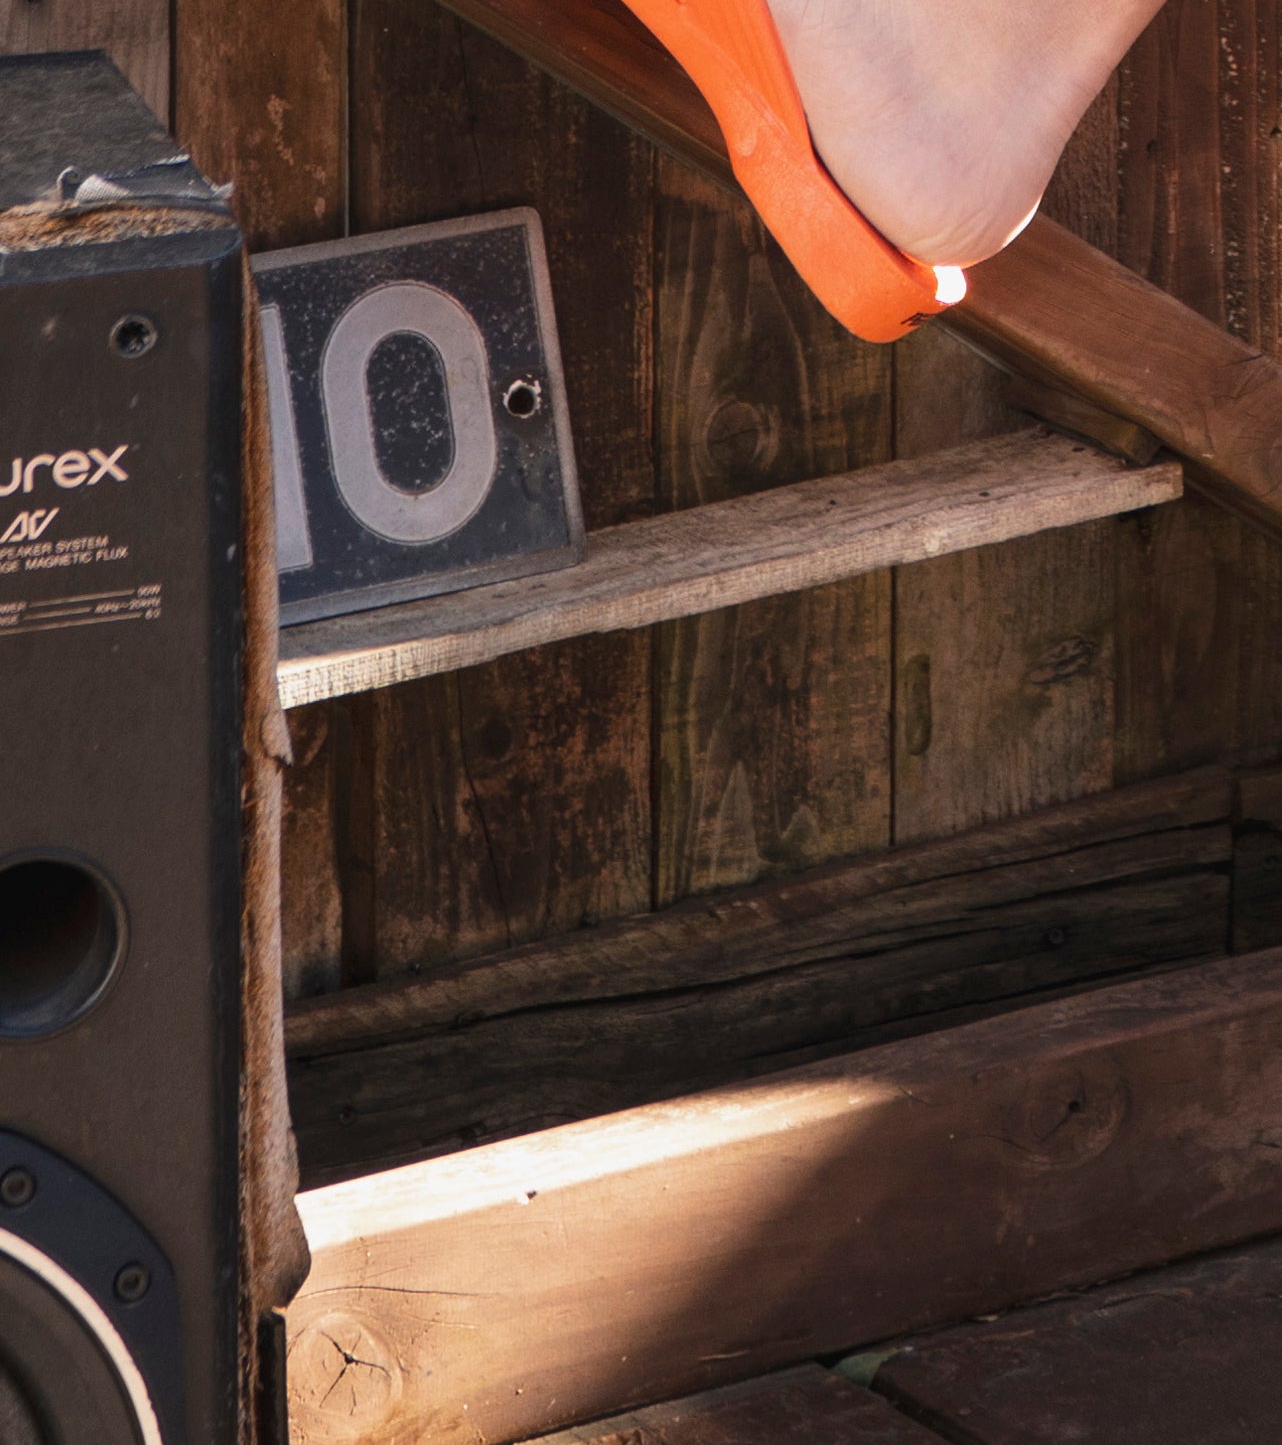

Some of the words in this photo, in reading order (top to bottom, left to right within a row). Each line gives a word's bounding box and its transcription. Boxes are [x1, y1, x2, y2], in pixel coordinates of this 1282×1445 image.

[55, 534, 109, 554] SYSTEM
[25, 551, 93, 571] MAGNETIC
[95, 545, 129, 561] FLUX
